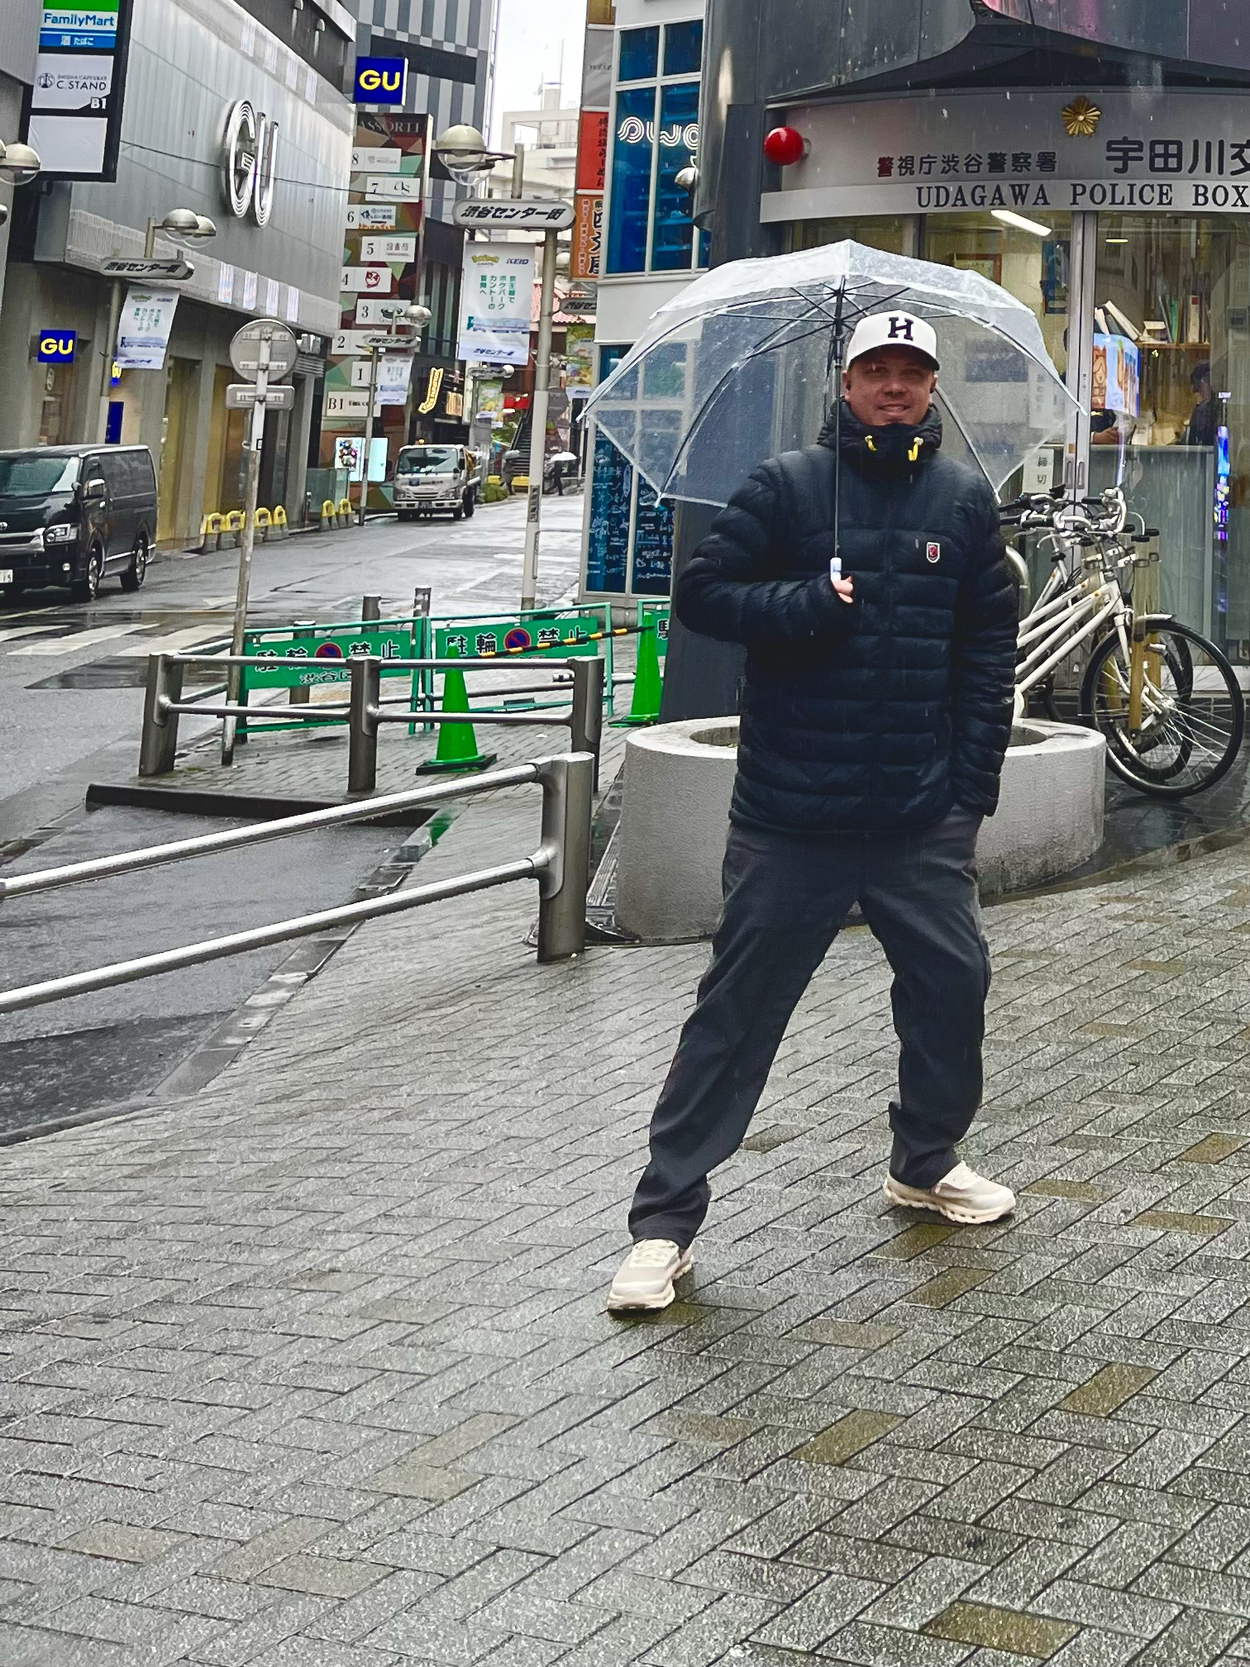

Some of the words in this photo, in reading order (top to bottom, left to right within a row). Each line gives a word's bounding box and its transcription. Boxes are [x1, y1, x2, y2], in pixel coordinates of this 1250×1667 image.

[43, 12, 115, 27] FamilyMart
[358, 69, 401, 92] GU
[90, 97, 107, 109] B1
[351, 153, 359, 166] 8
[876, 150, 1058, 178] 警視庁渋谷警察署
[371, 182, 379, 193] 7
[915, 181, 1052, 209] UDAGAWA
[1069, 181, 1174, 208] POLICE
[1192, 183, 1250, 208] BOX
[347, 211, 354, 224] 6
[460, 205, 567, 221] 渋谷センター街
[366, 243, 375, 256] 5
[361, 306, 369, 319] 3
[888, 316, 914, 341] H
[40, 337, 74, 355] GU
[337, 335, 346, 349] 2
[357, 368, 363, 381] 1
[328, 397, 344, 410] B1
